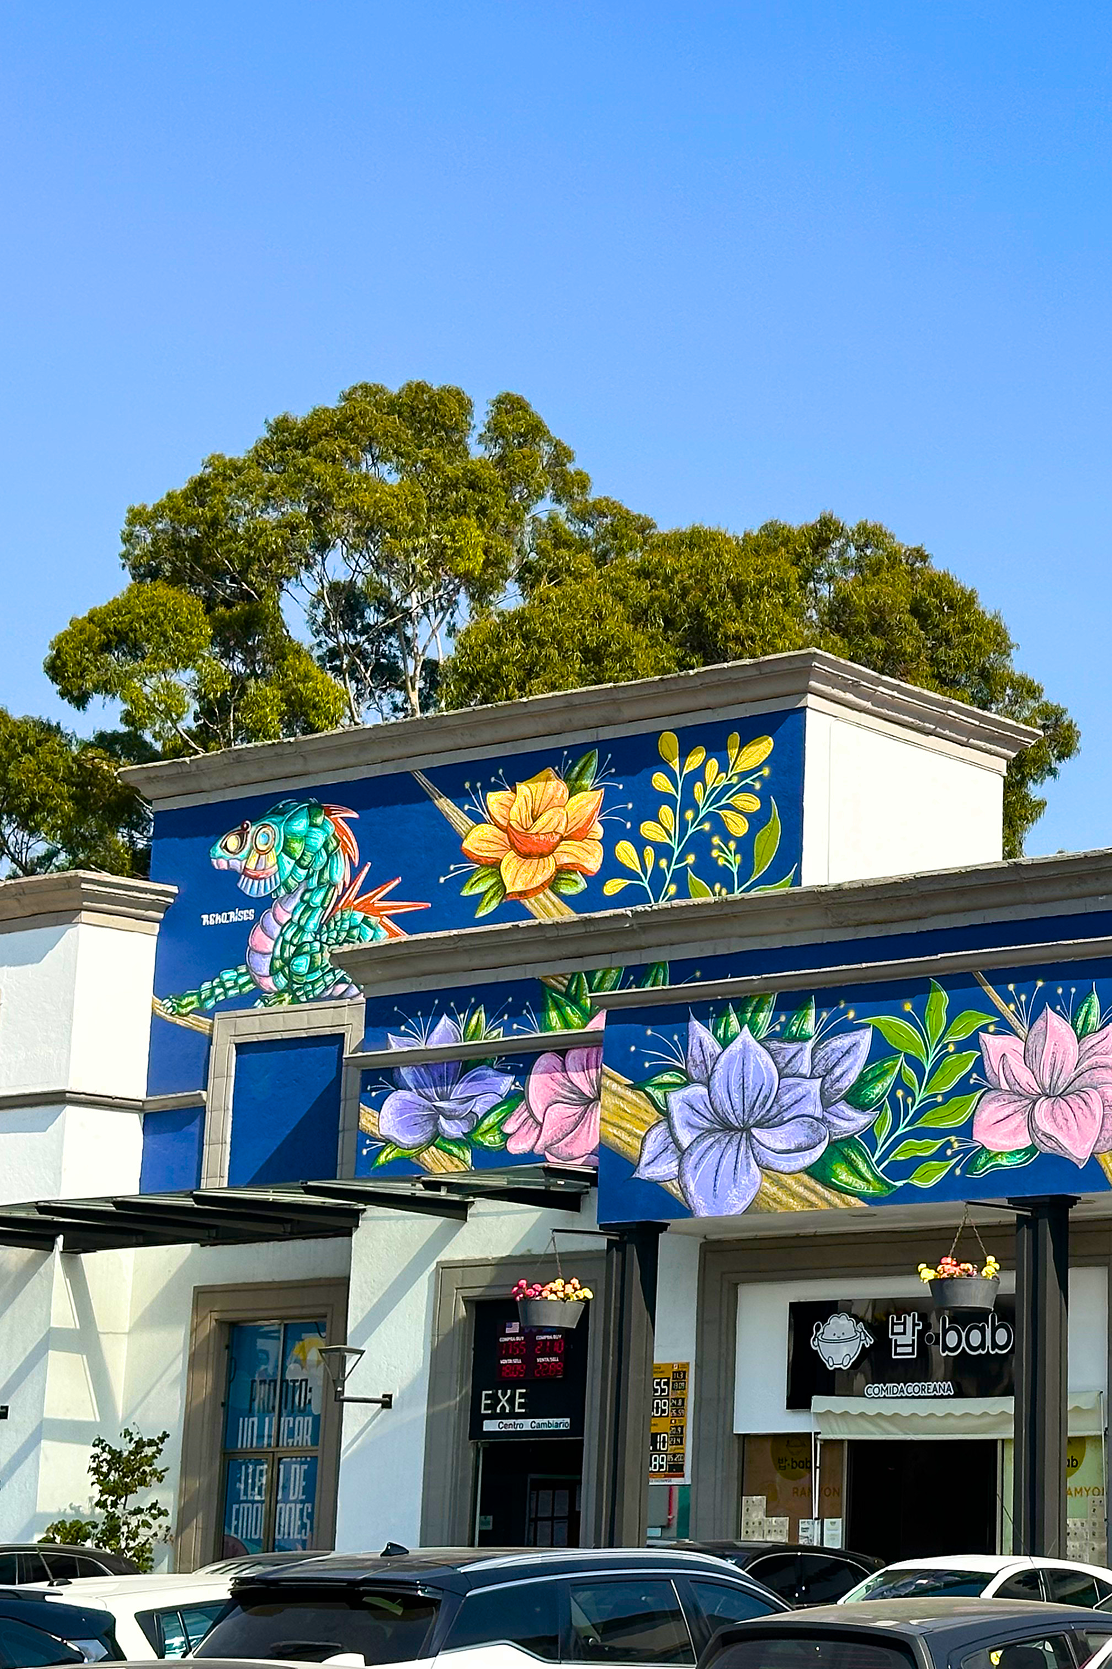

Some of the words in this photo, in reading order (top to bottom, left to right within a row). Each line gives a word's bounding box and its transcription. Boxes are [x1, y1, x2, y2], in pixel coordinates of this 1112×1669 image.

[481, 1389, 526, 1413] EXE
[498, 1421, 524, 1430] Centro
[530, 1420, 569, 1429] Cambiario
